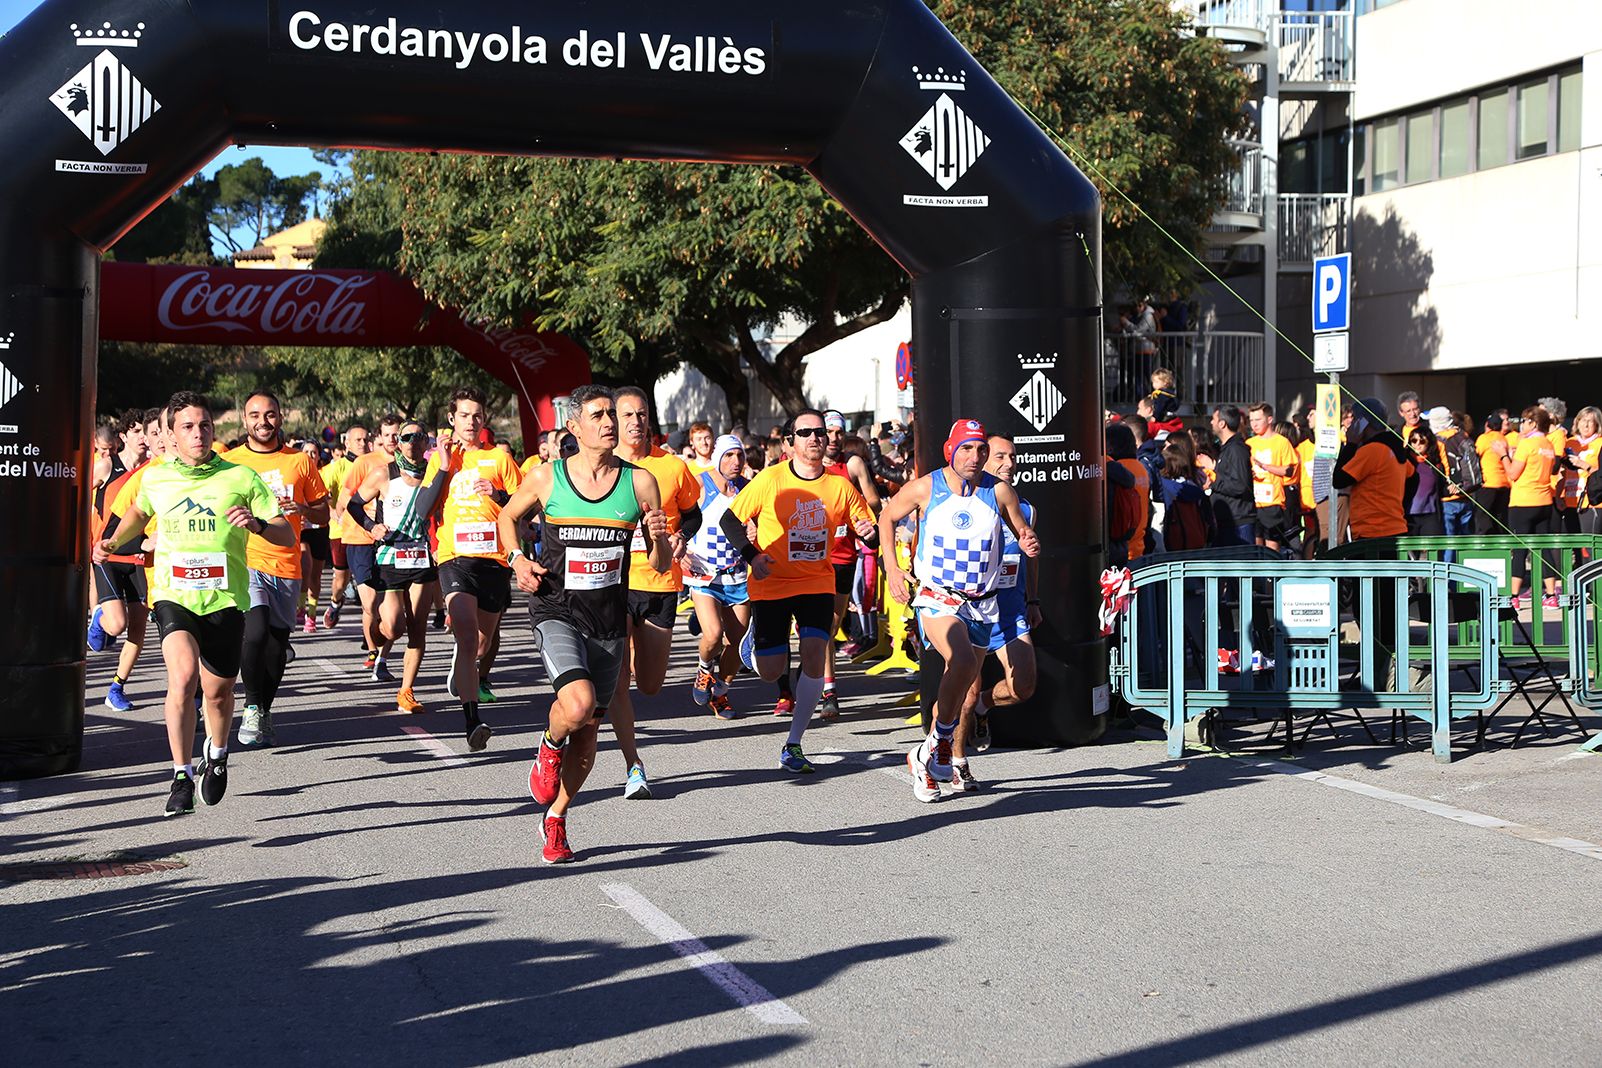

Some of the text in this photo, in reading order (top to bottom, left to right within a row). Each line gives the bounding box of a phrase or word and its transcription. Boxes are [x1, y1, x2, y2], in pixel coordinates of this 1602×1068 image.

[289, 11, 766, 76] Cerdanyola del Vallès
[61, 162, 90, 171] FACTA
[93, 164, 112, 172] NON
[1319, 264, 1342, 323] P
[158, 270, 376, 334] Coca-Cola
[22, 443, 40, 456] de
[1016, 450, 1081, 464] ntament de
[0, 460, 77, 479] del Vallès
[1051, 466, 1073, 482] del
[1076, 463, 1103, 480] Vallès
[188, 519, 216, 532] RUN
[558, 527, 615, 542] CERDANYOLA
[803, 543, 816, 552] 75
[184, 567, 210, 579] 293
[583, 562, 608, 573] 180
